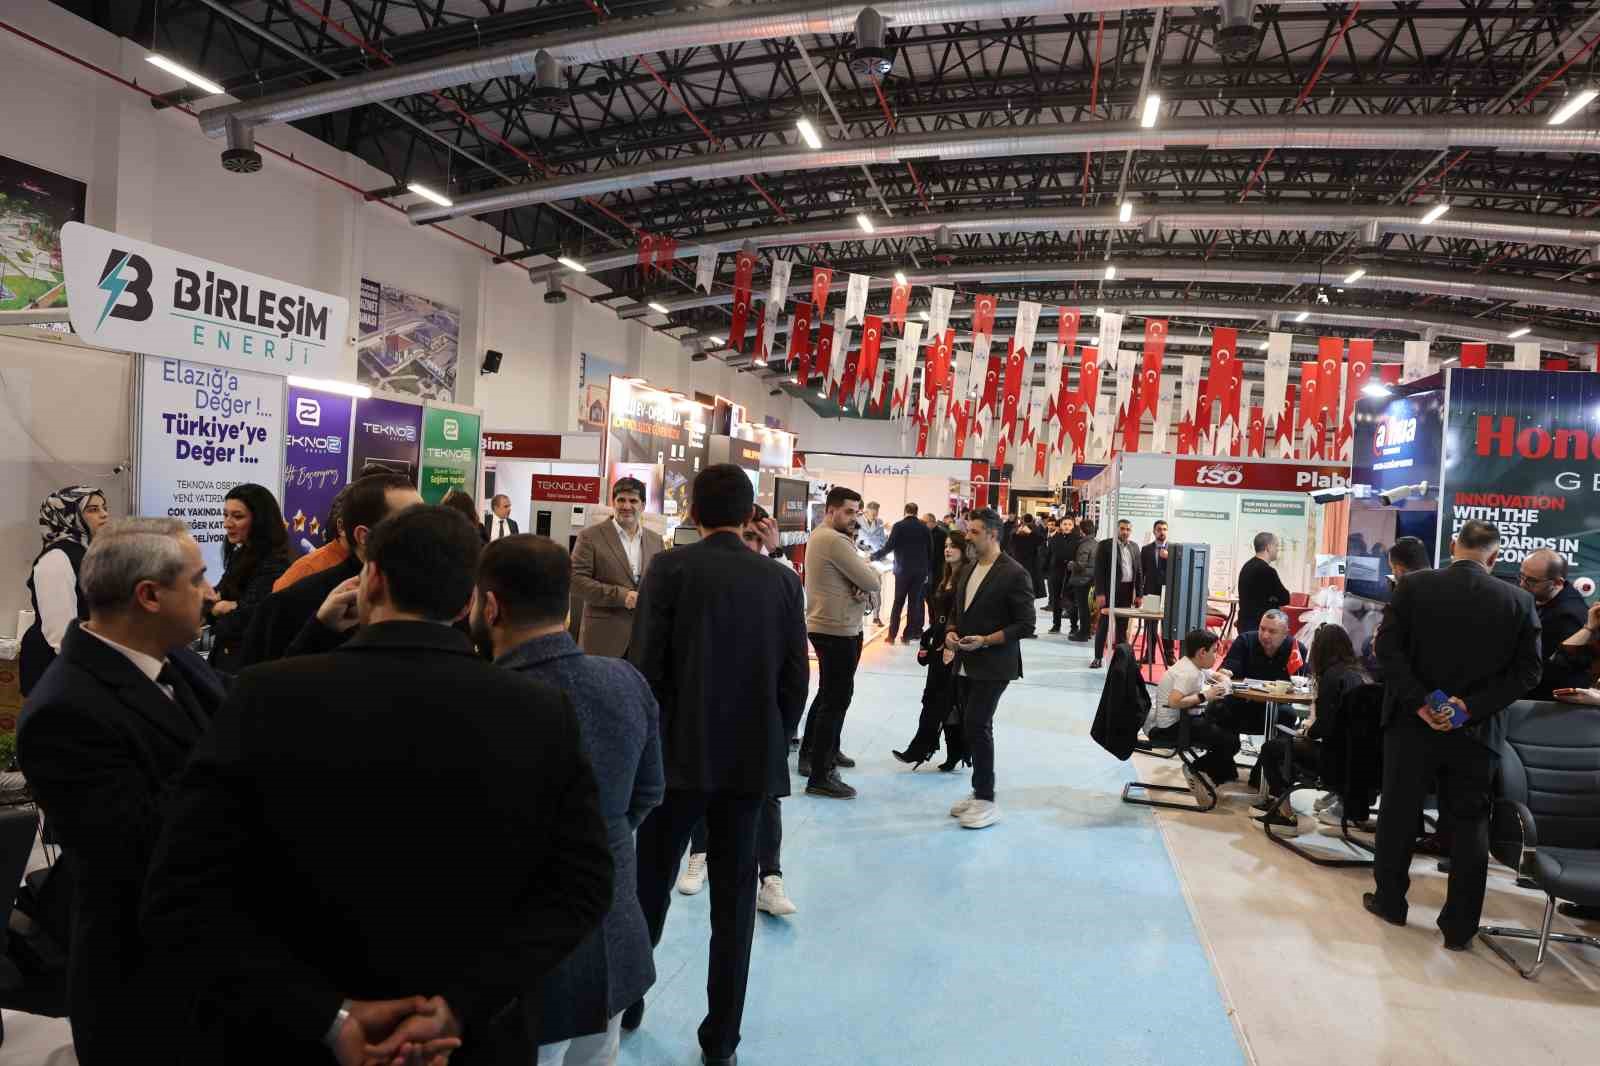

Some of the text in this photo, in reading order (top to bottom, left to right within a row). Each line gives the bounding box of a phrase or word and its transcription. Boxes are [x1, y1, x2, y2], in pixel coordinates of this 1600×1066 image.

[173, 267, 329, 341] BİRLEŞİM
[162, 359, 239, 395] Elazığ'a
[195, 389, 252, 418] Değer
[162, 413, 267, 445] Türkiye'ye
[1476, 415, 1600, 460] Hon
[176, 440, 236, 466] Değer
[1453, 505, 1540, 523] WITH THE
[1455, 491, 1566, 512] INNOVATION
[1559, 539, 1580, 553] IN
